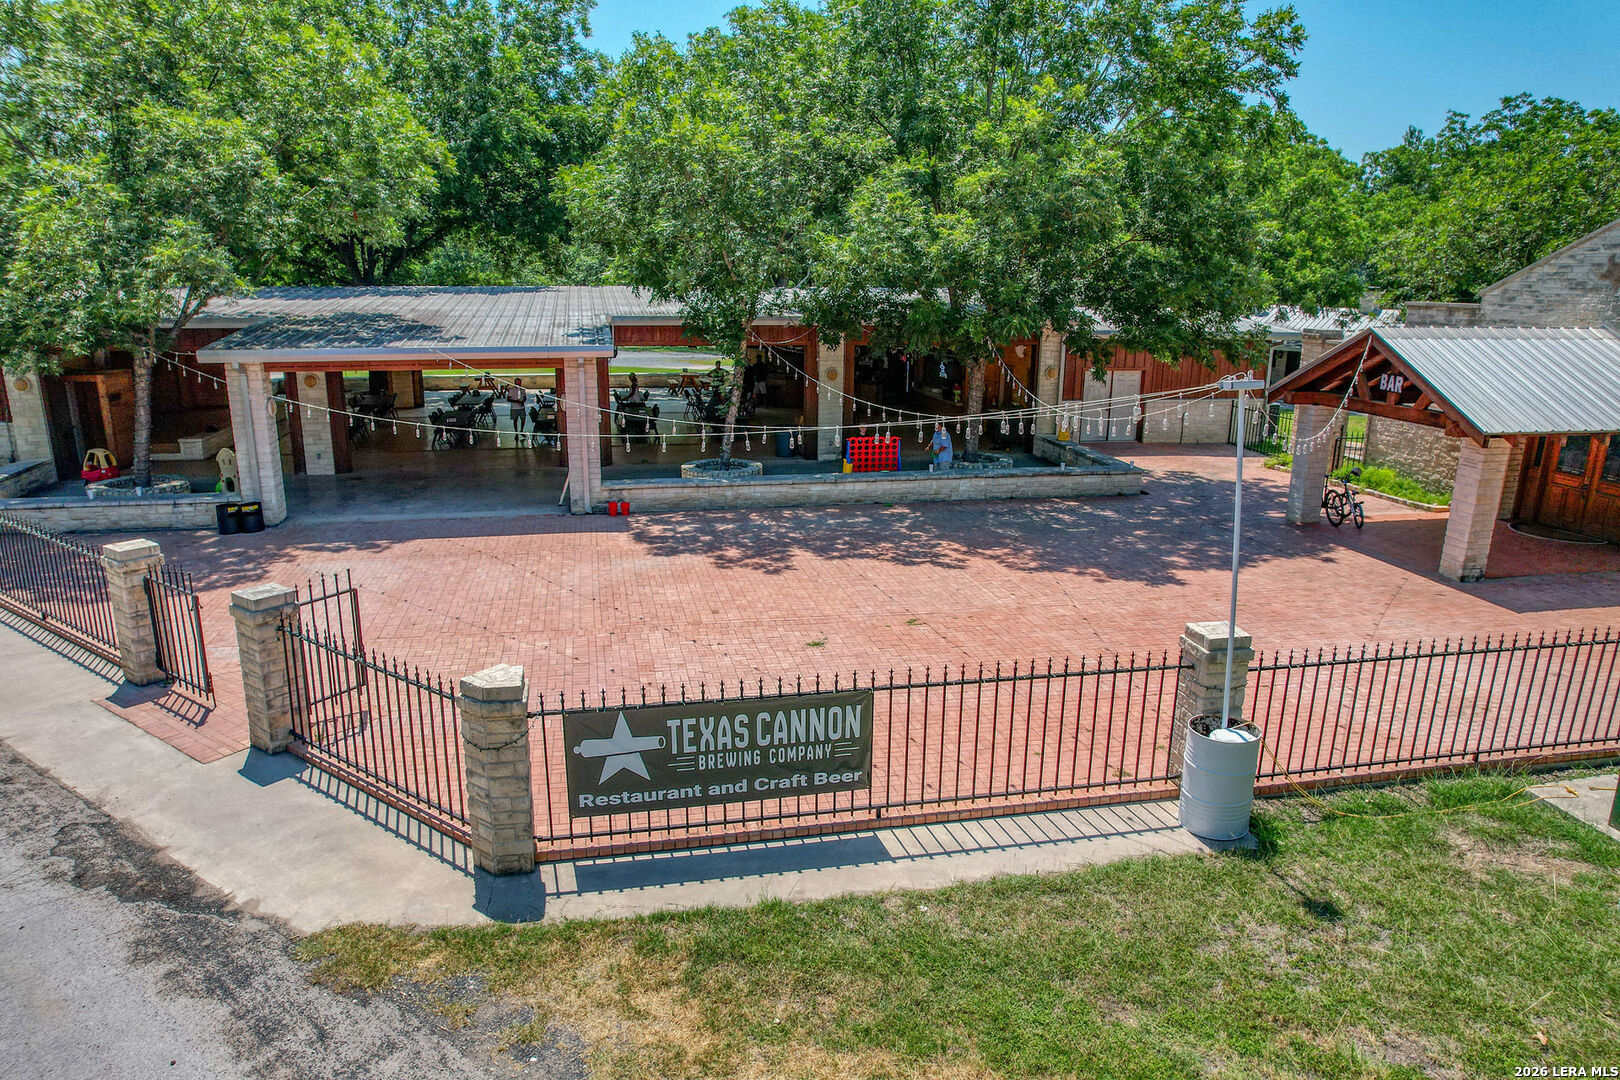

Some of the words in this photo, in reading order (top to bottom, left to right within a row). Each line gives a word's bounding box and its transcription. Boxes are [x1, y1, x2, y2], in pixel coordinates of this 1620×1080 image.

[1380, 373, 1404, 393] BAR
[666, 714, 750, 755] TEXAS
[756, 704, 862, 747] CANNON
[698, 749, 761, 771] BREWING
[769, 743, 832, 764] COMPANY
[578, 784, 703, 808] Restaurant
[707, 778, 748, 796] and
[754, 773, 808, 791] Craft
[813, 770, 863, 786] Beer
